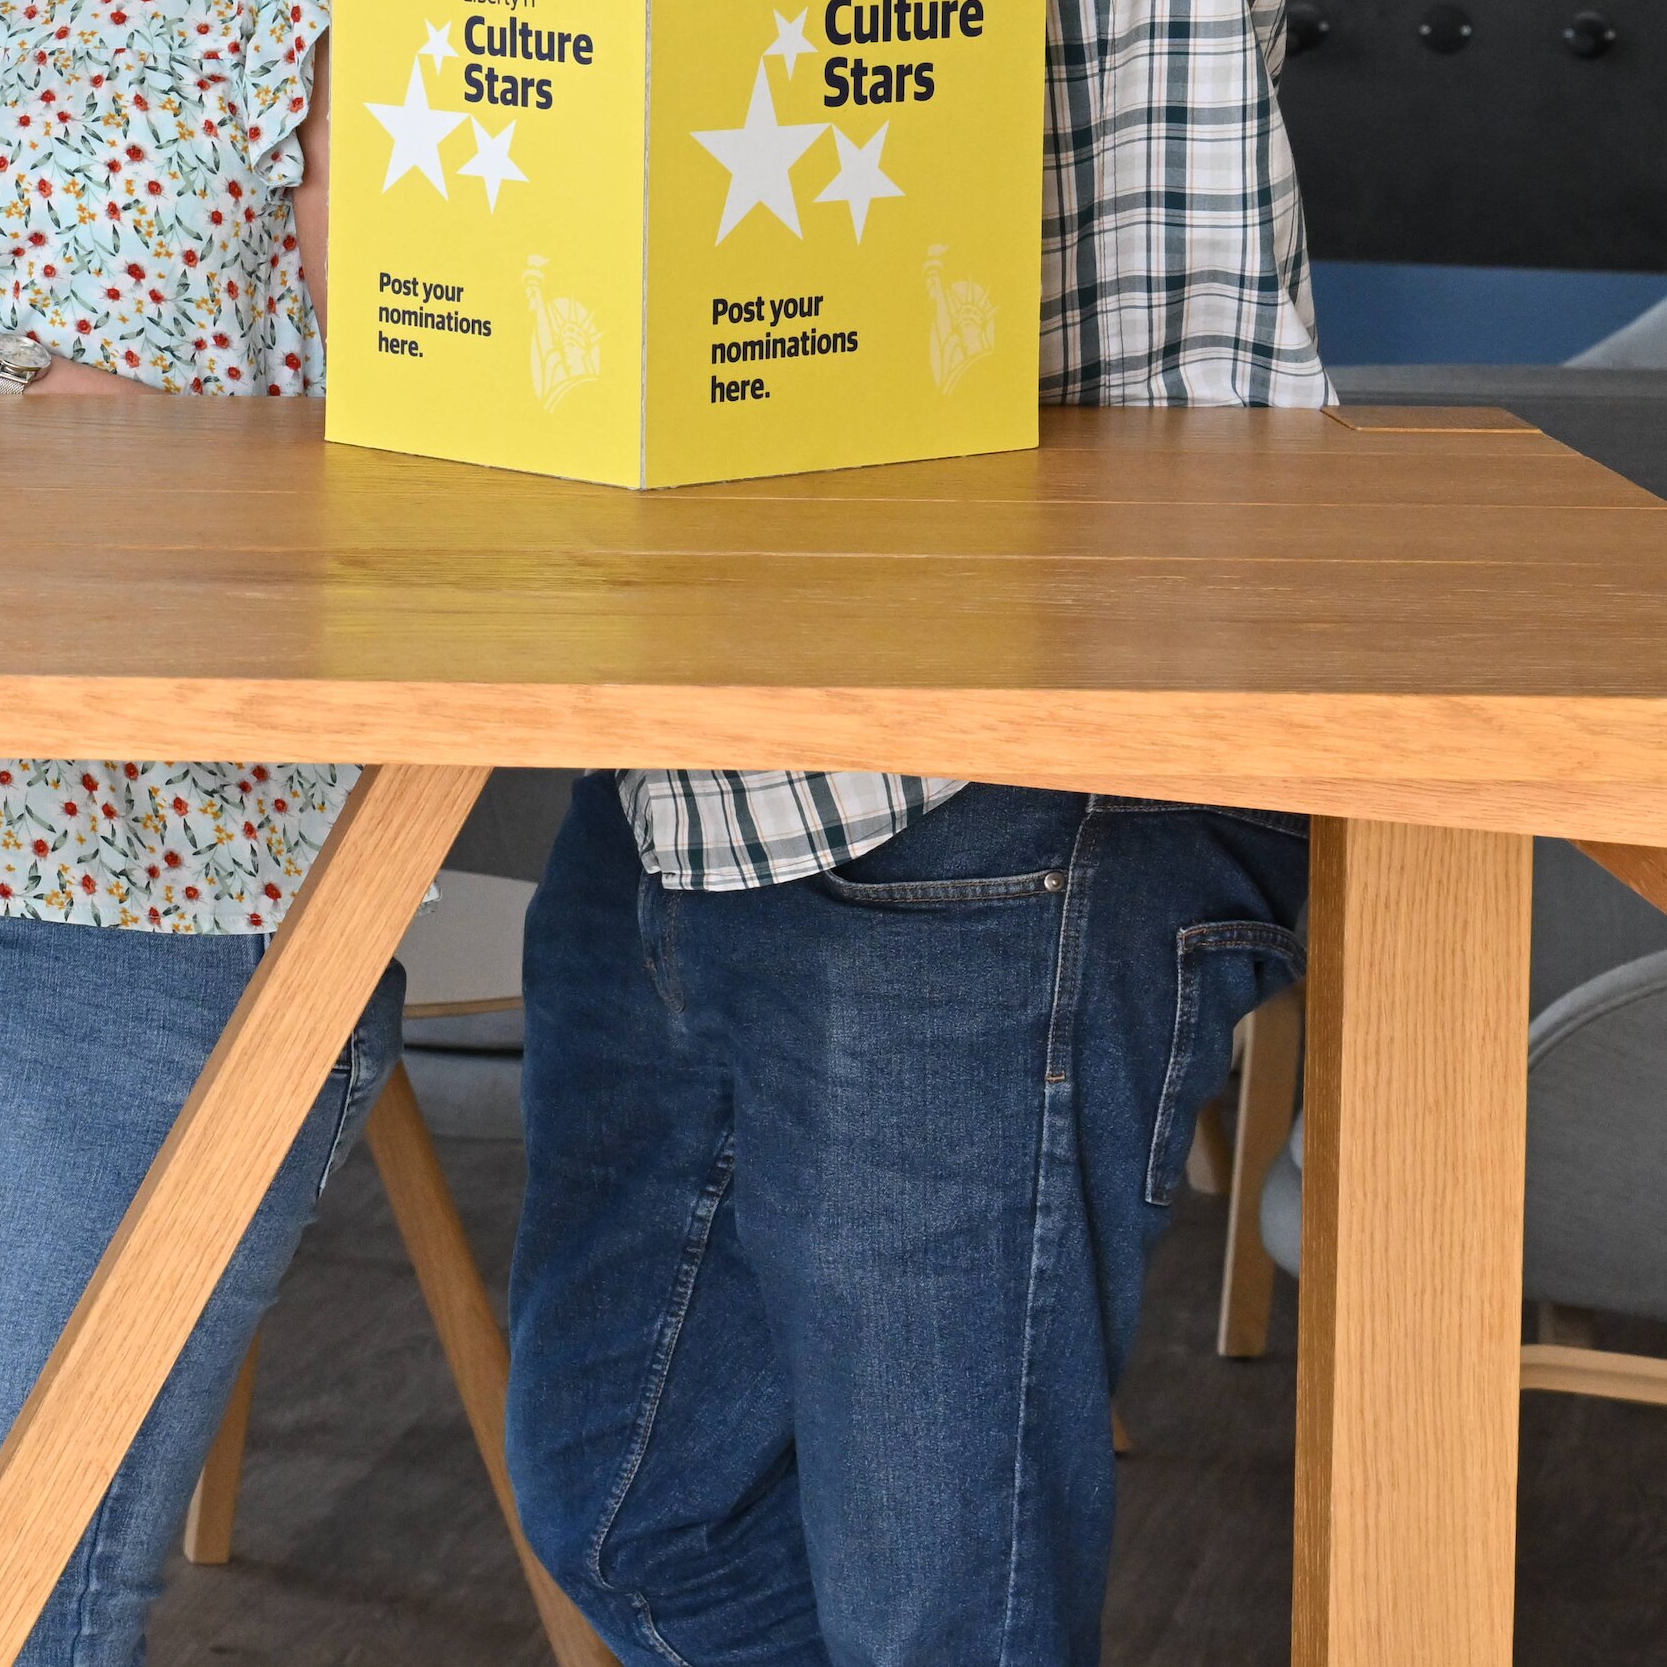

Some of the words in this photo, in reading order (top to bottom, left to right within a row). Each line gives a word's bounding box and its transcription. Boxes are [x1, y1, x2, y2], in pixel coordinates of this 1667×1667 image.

[464, 15, 594, 65] Culture
[464, 63, 553, 110] Stars
[823, 56, 935, 108] Stars
[379, 272, 419, 297] Post
[422, 282, 464, 303] your
[379, 306, 492, 337] nominations
[712, 296, 765, 325] Post
[769, 295, 824, 327] your
[378, 330, 423, 358] here.
[711, 328, 859, 364] nominations
[711, 375, 770, 404] here.
